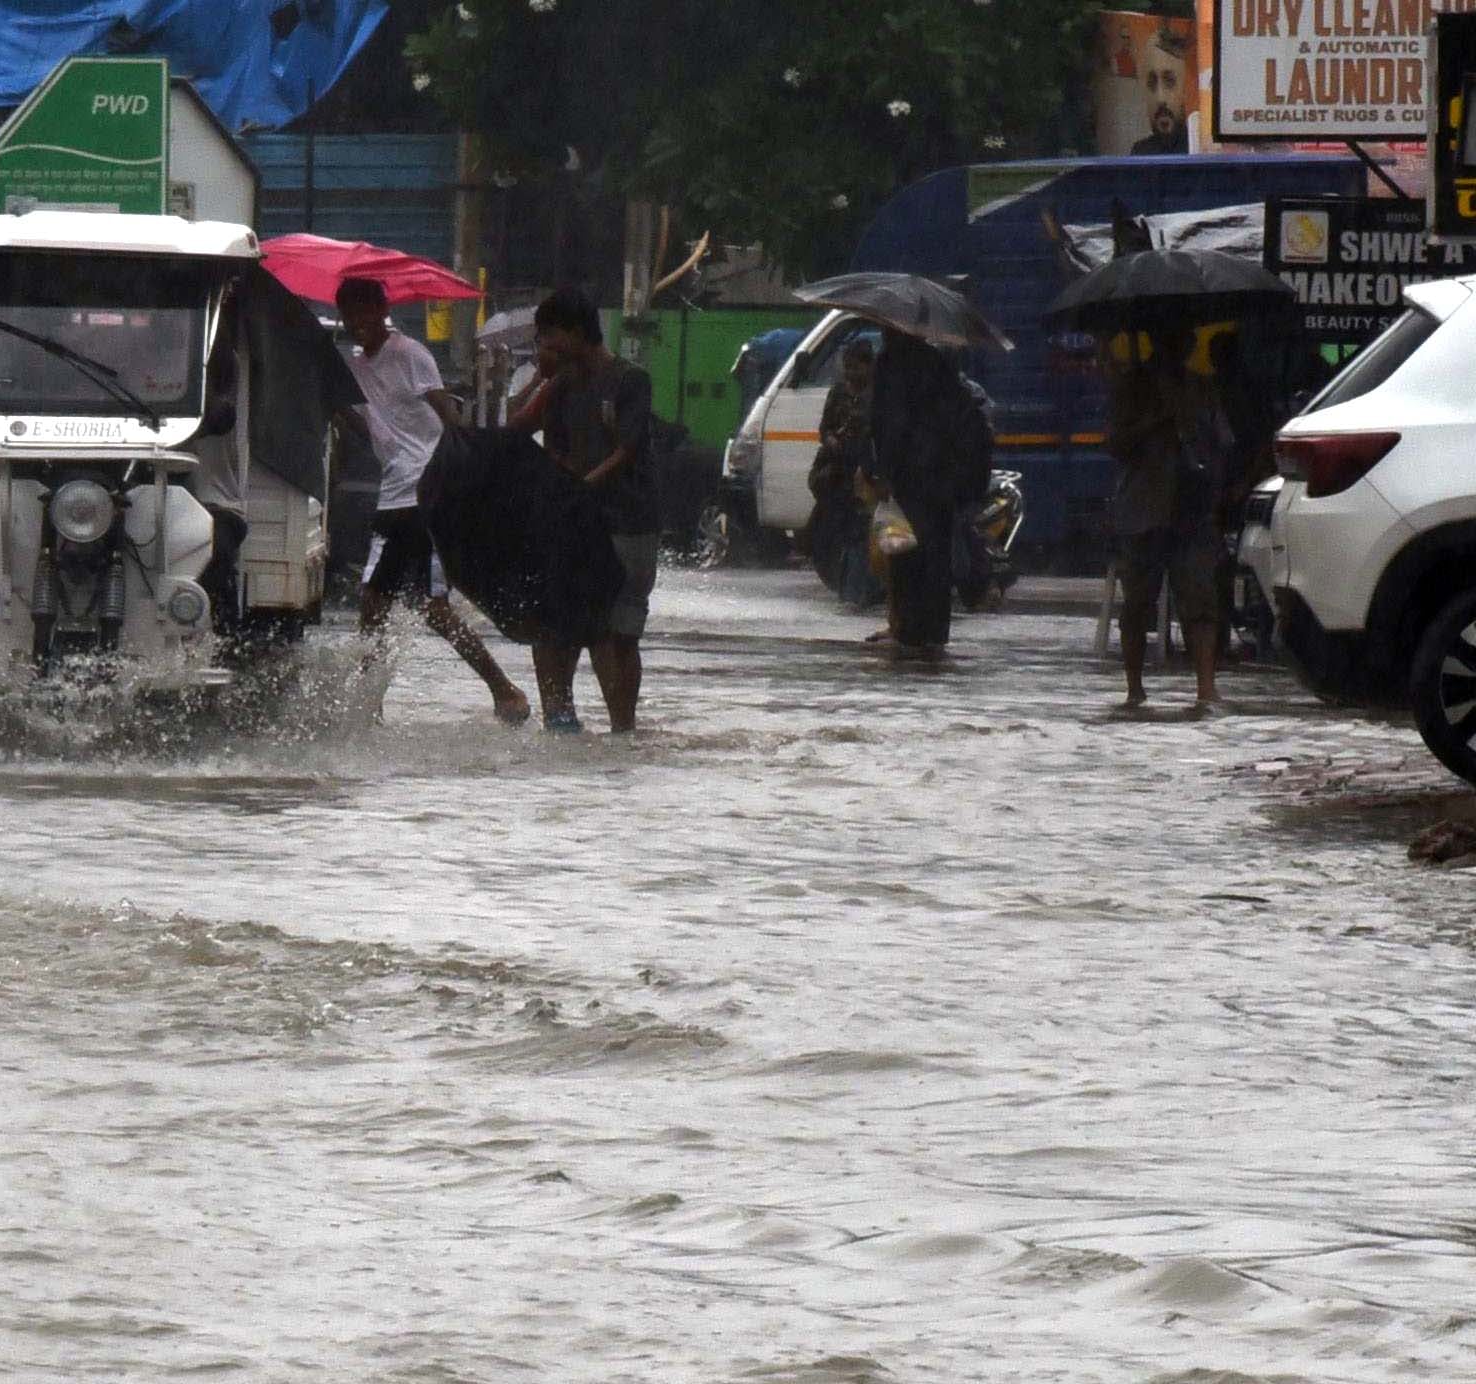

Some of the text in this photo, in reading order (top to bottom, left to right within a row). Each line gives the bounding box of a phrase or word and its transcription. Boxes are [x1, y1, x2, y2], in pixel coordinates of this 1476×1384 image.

[1232, 0, 1303, 37] DRY
[1299, 41, 1420, 54] & AUTOMATIC
[1265, 58, 1424, 106] LAUNDR
[91, 95, 149, 115] PWD
[1232, 109, 1425, 123] SPECIALIST RUGS & CU
[1340, 230, 1465, 264] SHWEA
[1280, 271, 1455, 306] MAKEO
[1305, 315, 1371, 330] BEAUTY
